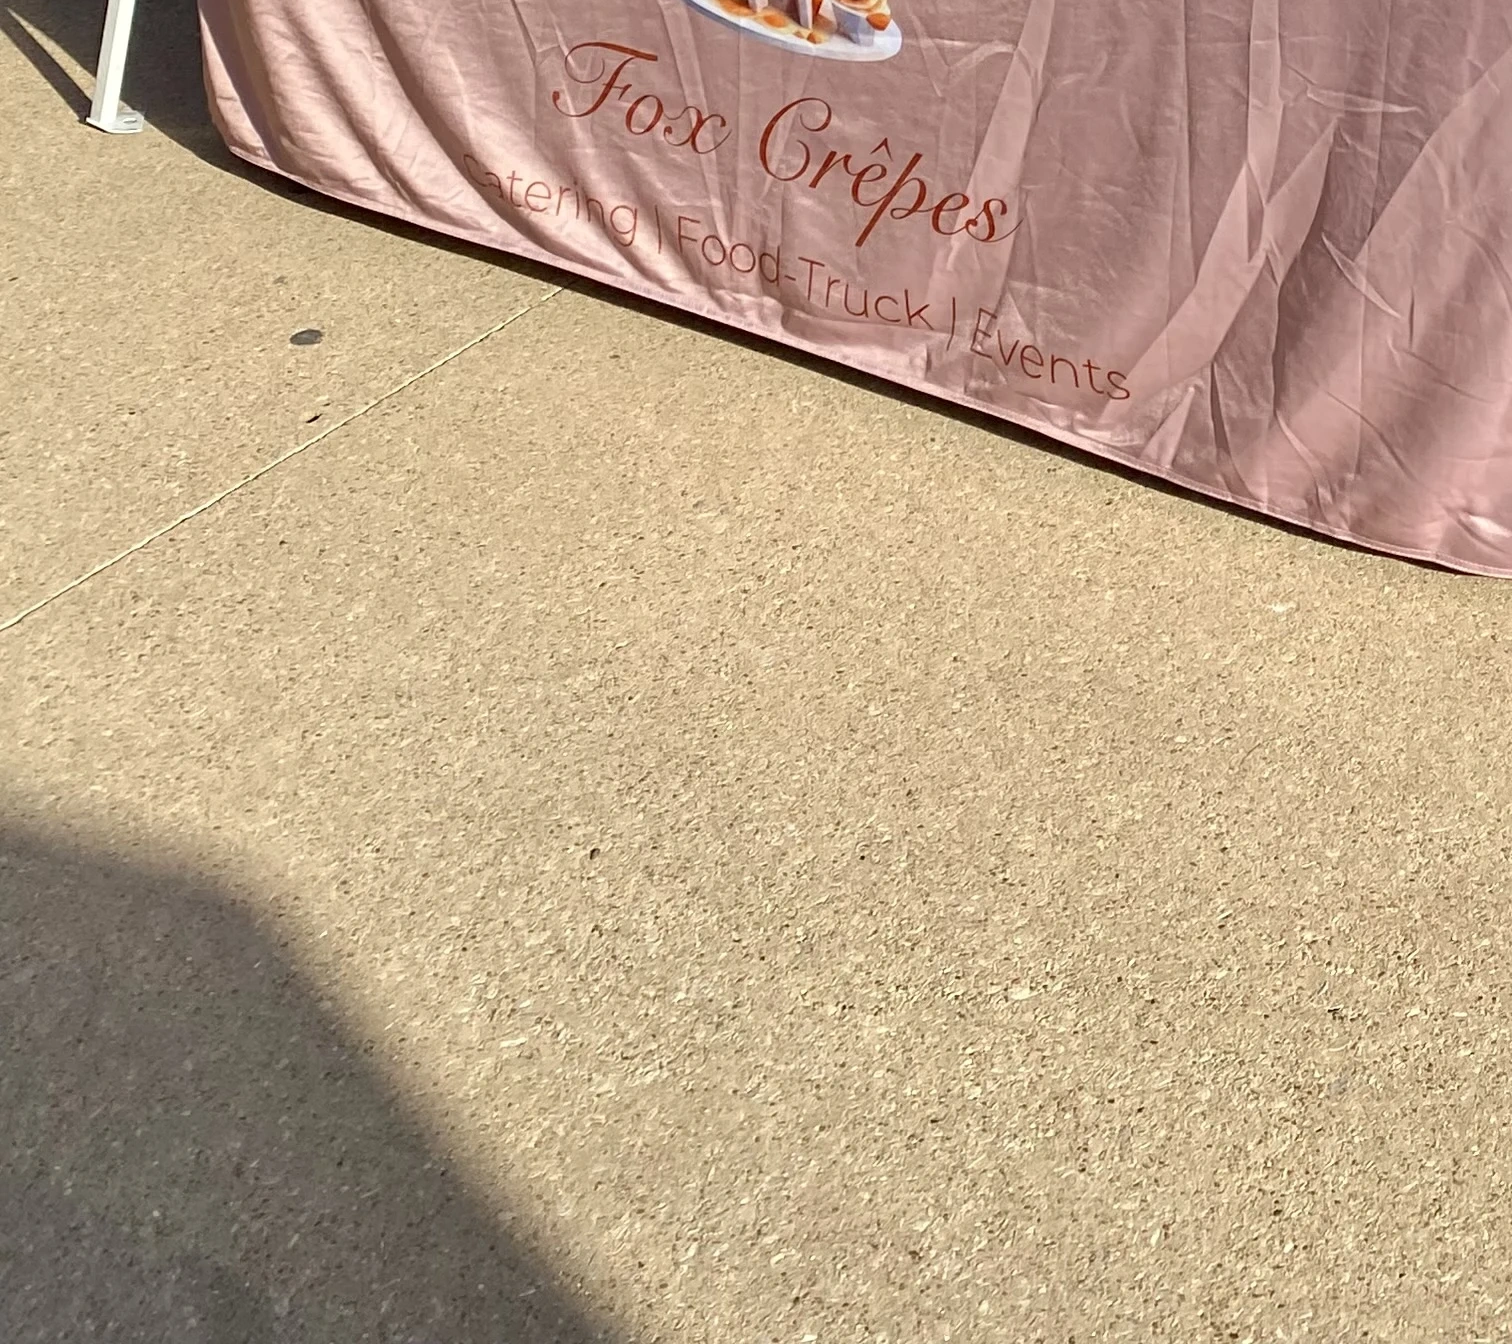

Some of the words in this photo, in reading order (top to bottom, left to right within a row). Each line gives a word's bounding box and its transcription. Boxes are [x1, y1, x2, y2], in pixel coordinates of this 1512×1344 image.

[552, 41, 732, 155] Fox
[759, 96, 1024, 247] Crêpes
[463, 153, 638, 248] Catering
[679, 214, 935, 332] Food-Truck
[970, 307, 1132, 402] Events
